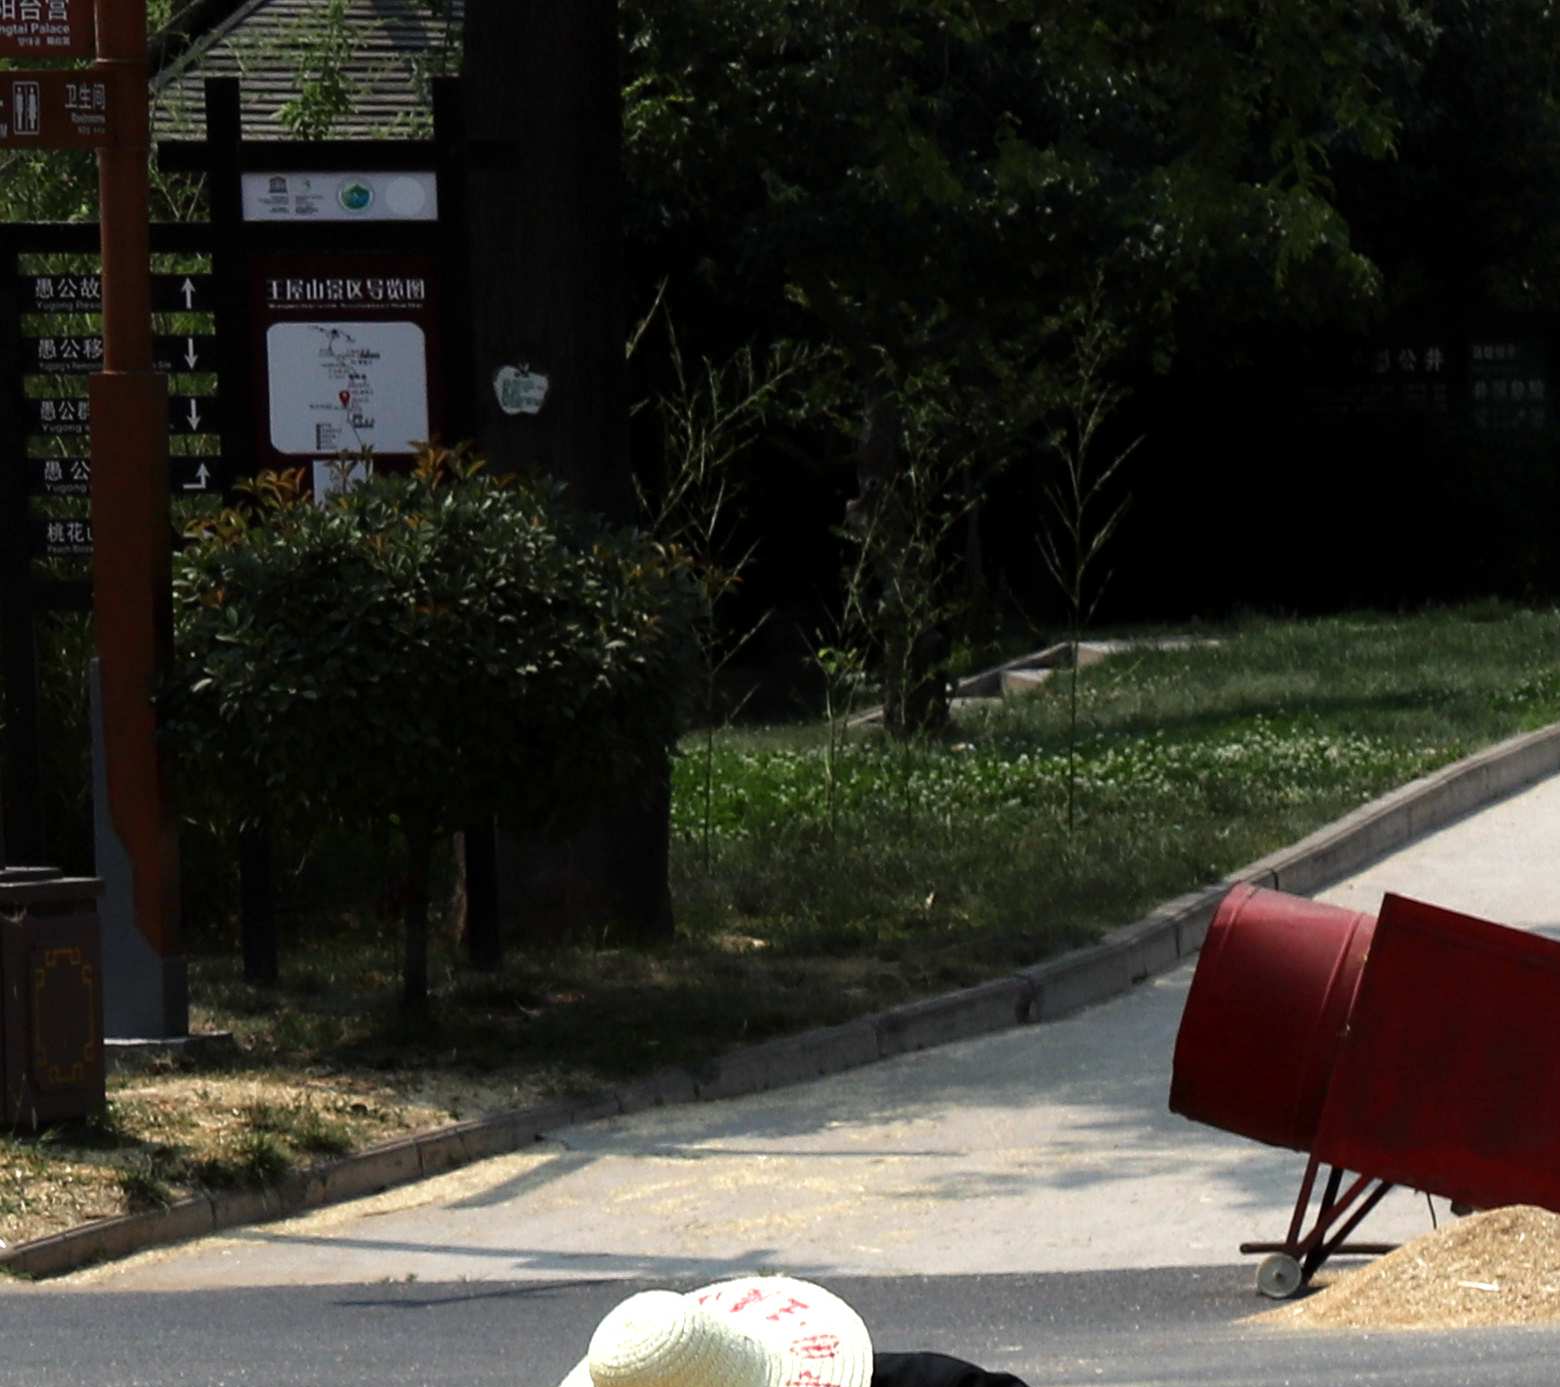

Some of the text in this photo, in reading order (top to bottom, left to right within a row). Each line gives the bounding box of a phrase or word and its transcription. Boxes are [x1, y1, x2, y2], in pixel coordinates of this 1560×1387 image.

[31, 23, 70, 35] Palace
[65, 82, 105, 110] 卫生间
[35, 277, 101, 299] 愚公故
[265, 278, 426, 300] 王屋山景区导览图
[41, 423, 82, 433] Yugong
[44, 460, 91, 481] 愚公
